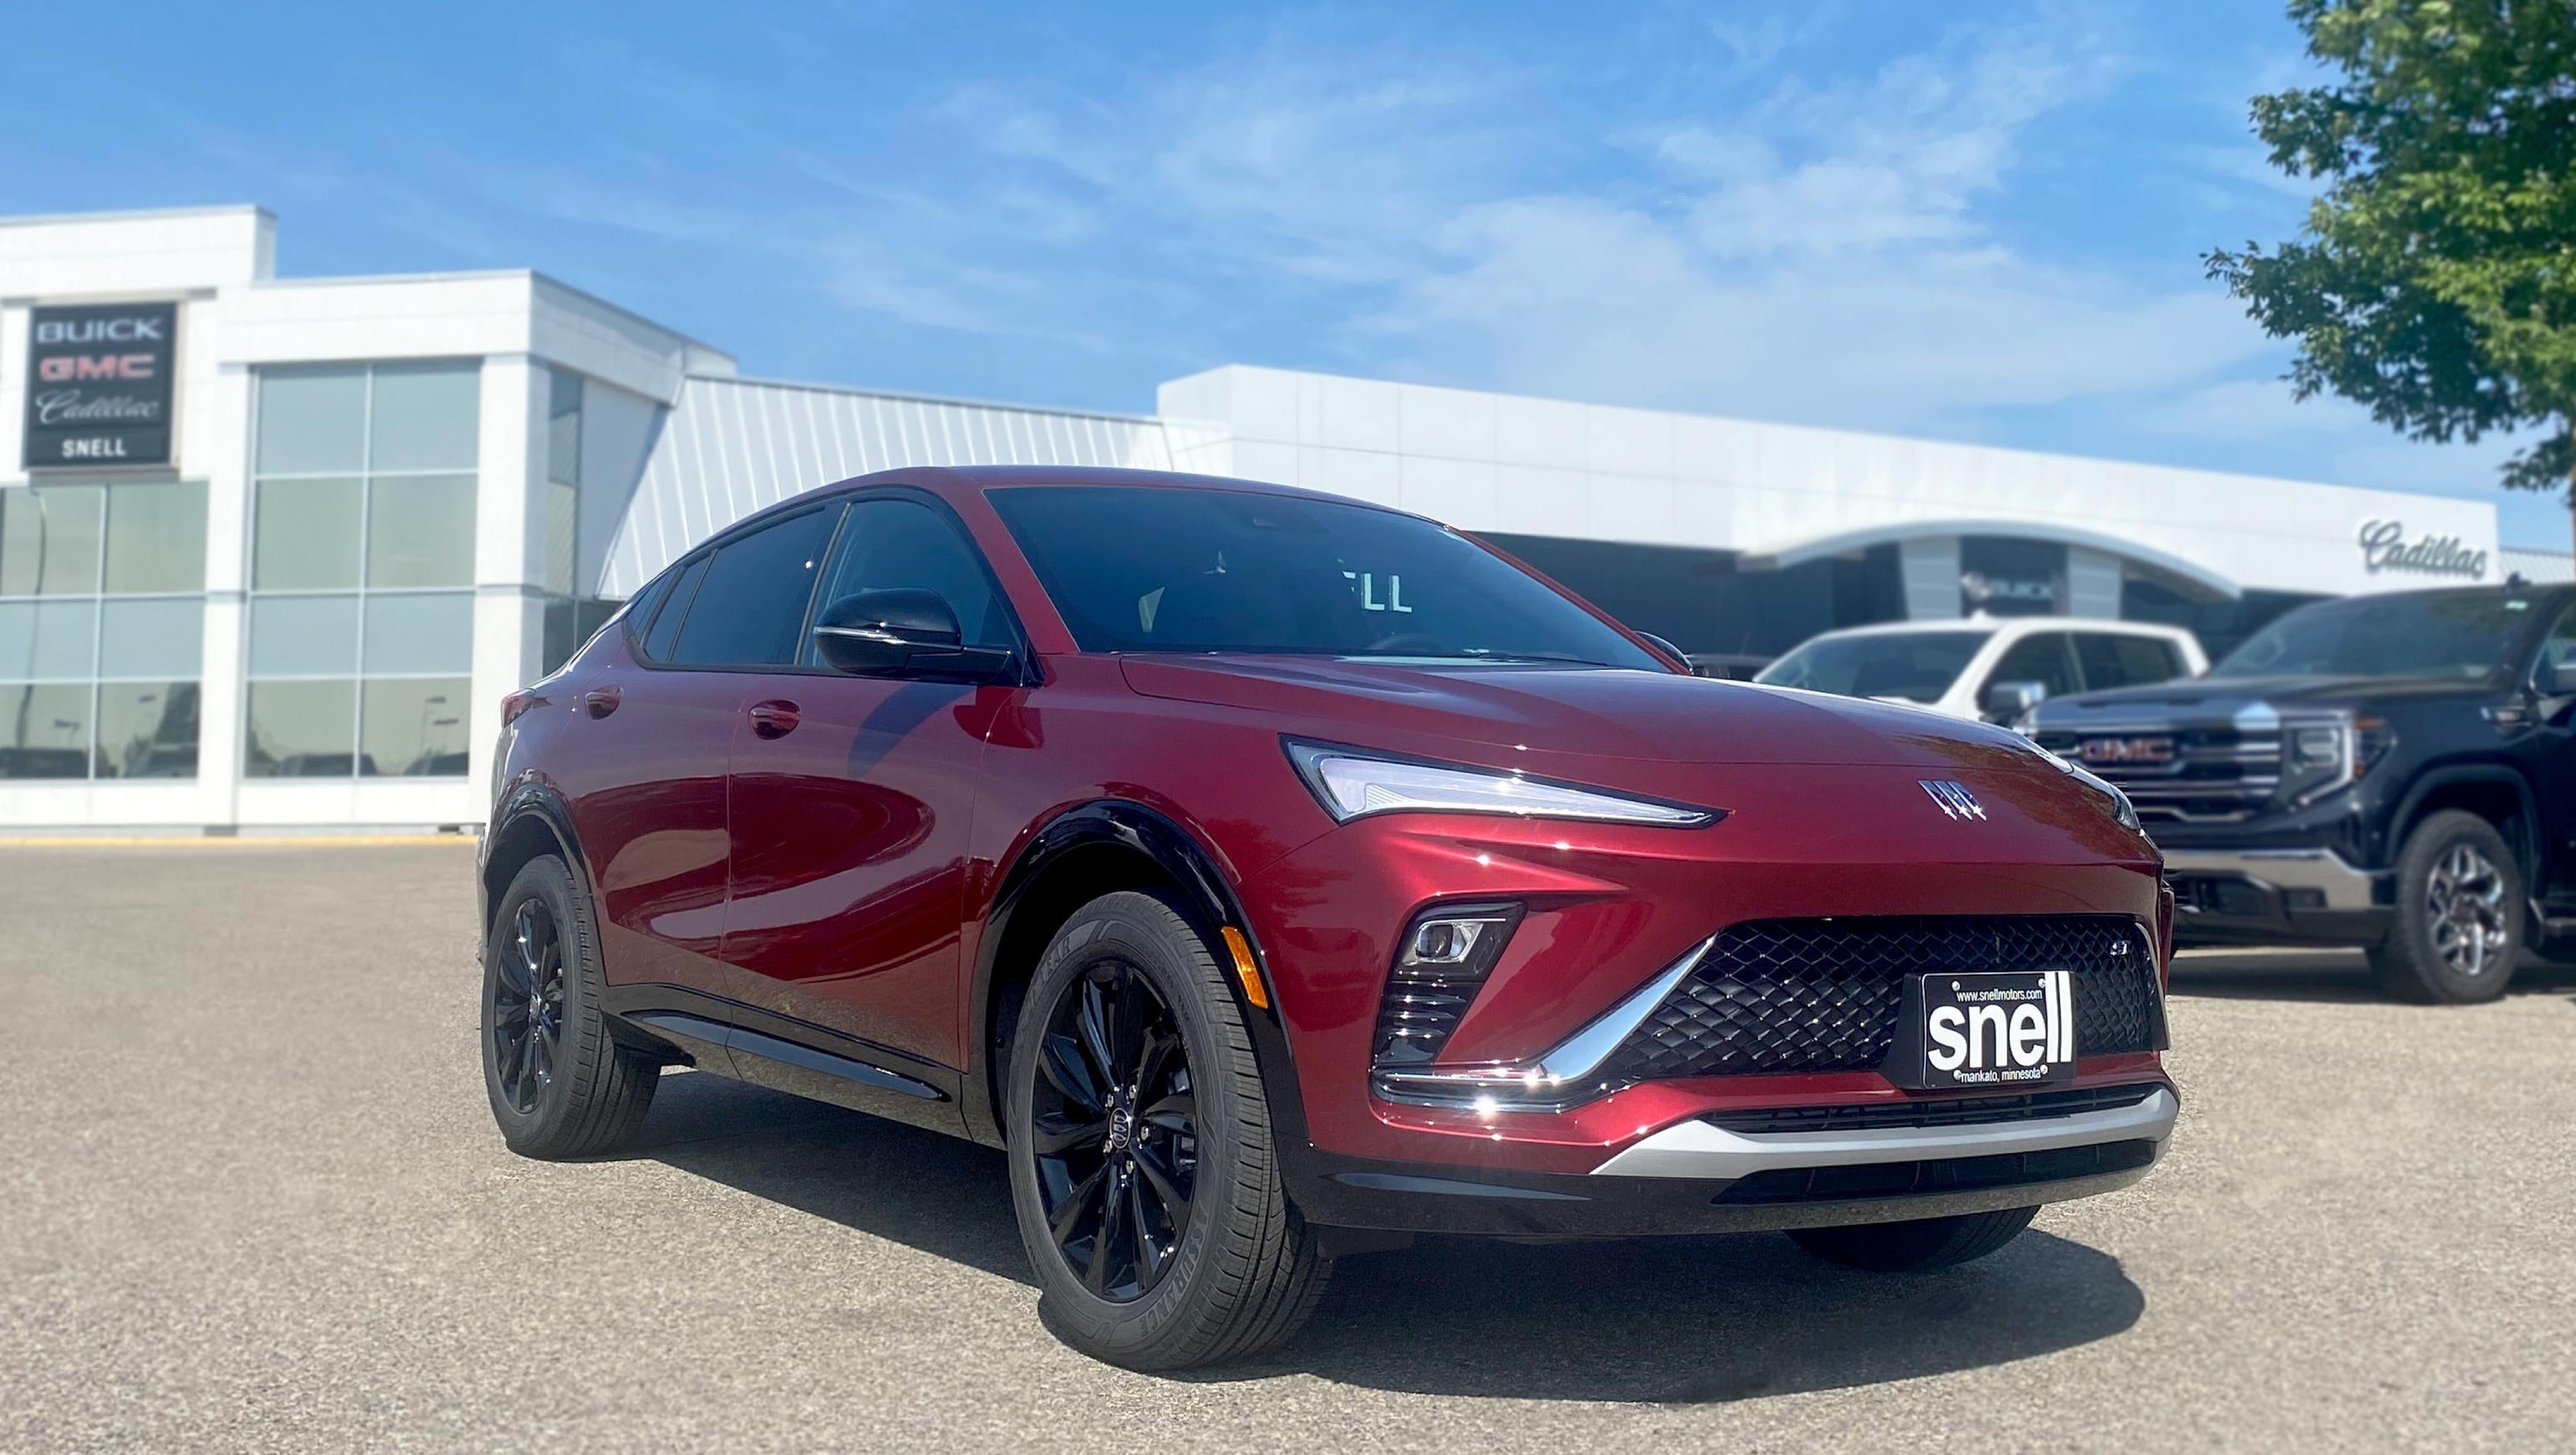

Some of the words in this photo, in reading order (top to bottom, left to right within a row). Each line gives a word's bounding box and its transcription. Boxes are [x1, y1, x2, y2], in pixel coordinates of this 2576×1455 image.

[36, 317, 163, 343] BUICK
[40, 353, 155, 381] GMC
[36, 388, 159, 425] Cadillac
[62, 438, 127, 458] SNELL
[2359, 519, 2487, 580] Cadillac
[1342, 571, 1412, 613] LL
[2082, 738, 2174, 762] GMC
[1957, 989, 2043, 1002] www.snellmotors.com
[1927, 971, 2073, 1071] snell
[1961, 1070, 2000, 1083] mankato,
[2002, 1068, 2041, 1081] minnesota
